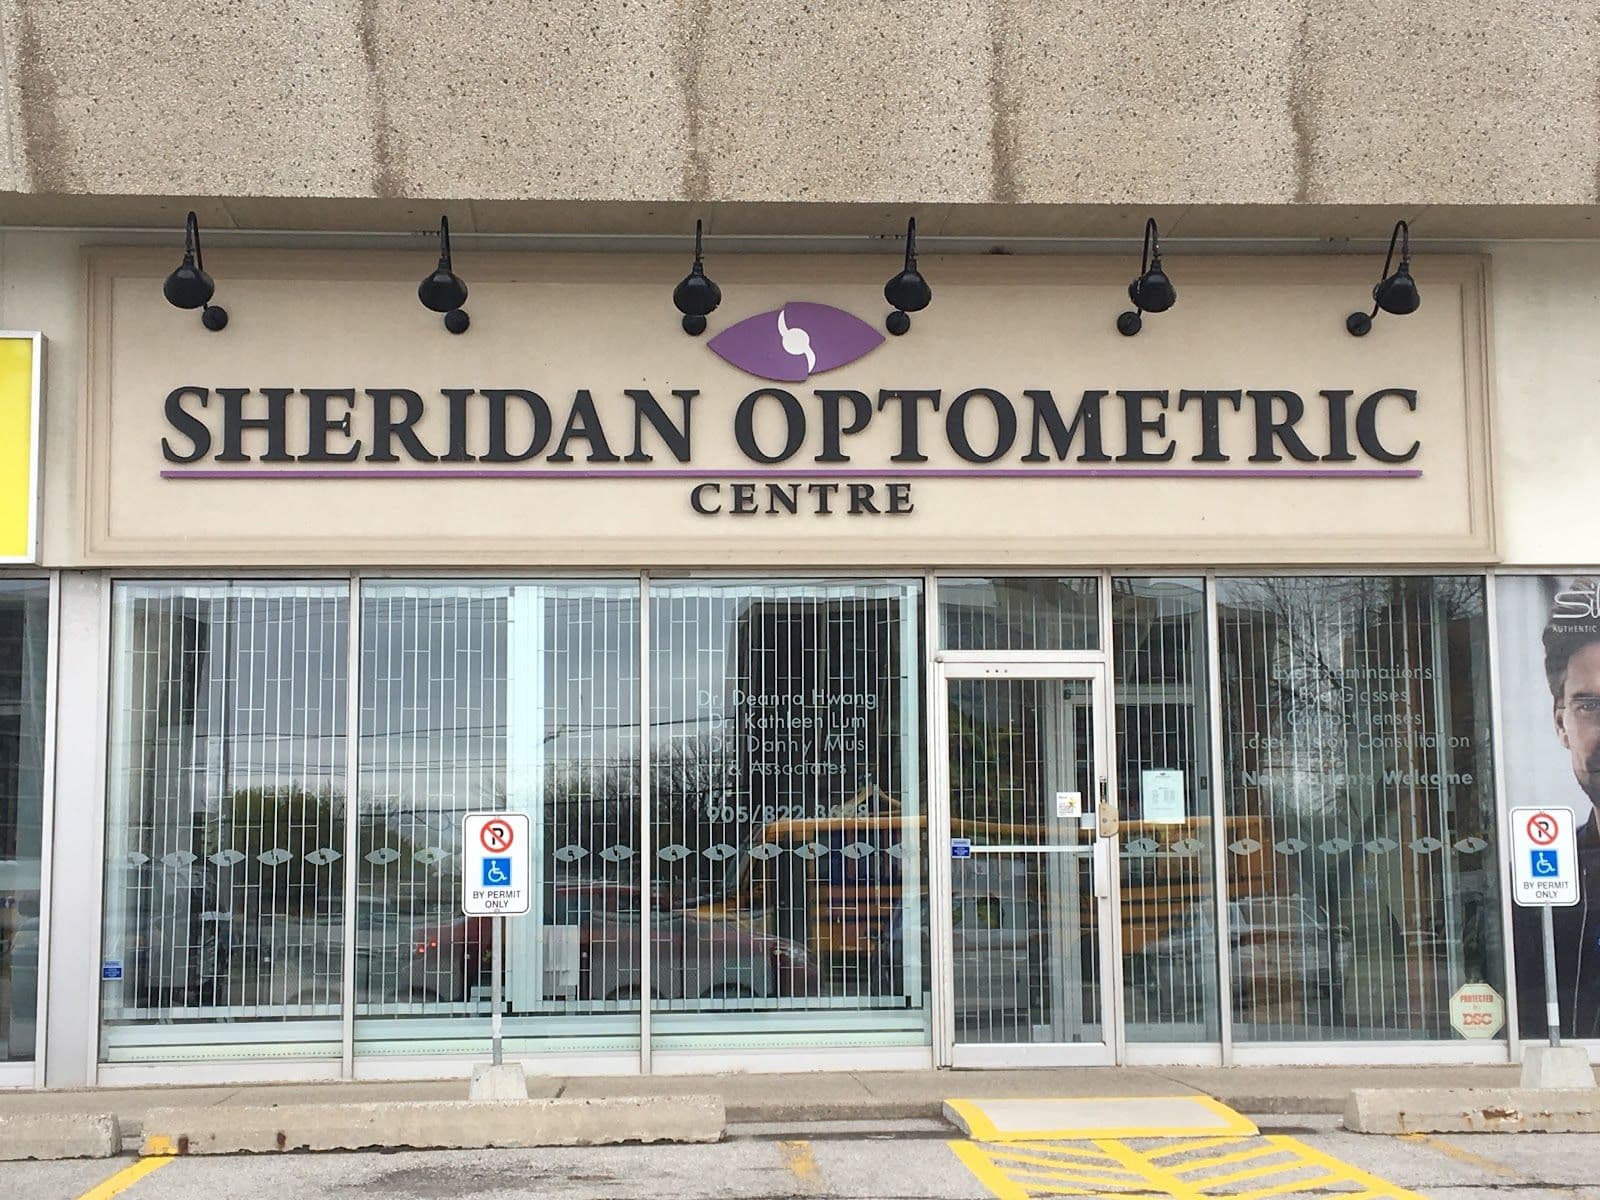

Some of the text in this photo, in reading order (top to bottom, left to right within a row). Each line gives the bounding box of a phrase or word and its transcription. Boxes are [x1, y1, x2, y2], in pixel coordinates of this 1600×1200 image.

[161, 386, 1421, 464] SHERIDAN OPTOMETRIC
[690, 482, 914, 516] CENTRE
[1552, 625, 1597, 633] AUTHENTIC
[1312, 664, 1433, 680] Examinations
[698, 689, 877, 709] Dr. Deanna Hwang
[1339, 686, 1408, 703] Gasses
[710, 712, 865, 729] Dr. Kathleen Lum
[748, 736, 812, 757] Danny
[824, 736, 865, 752] Mus
[1297, 733, 1349, 749] Vsion
[1358, 732, 1470, 749] Consultaon
[751, 759, 847, 776] Associates
[1383, 769, 1473, 786] Welcome
[1523, 881, 1569, 889] BY PERMIT
[473, 890, 521, 899] BY PERMIT
[1535, 890, 1558, 899] ONLY
[485, 900, 509, 908] ONLY
[1462, 1013, 1493, 1026] DSC
